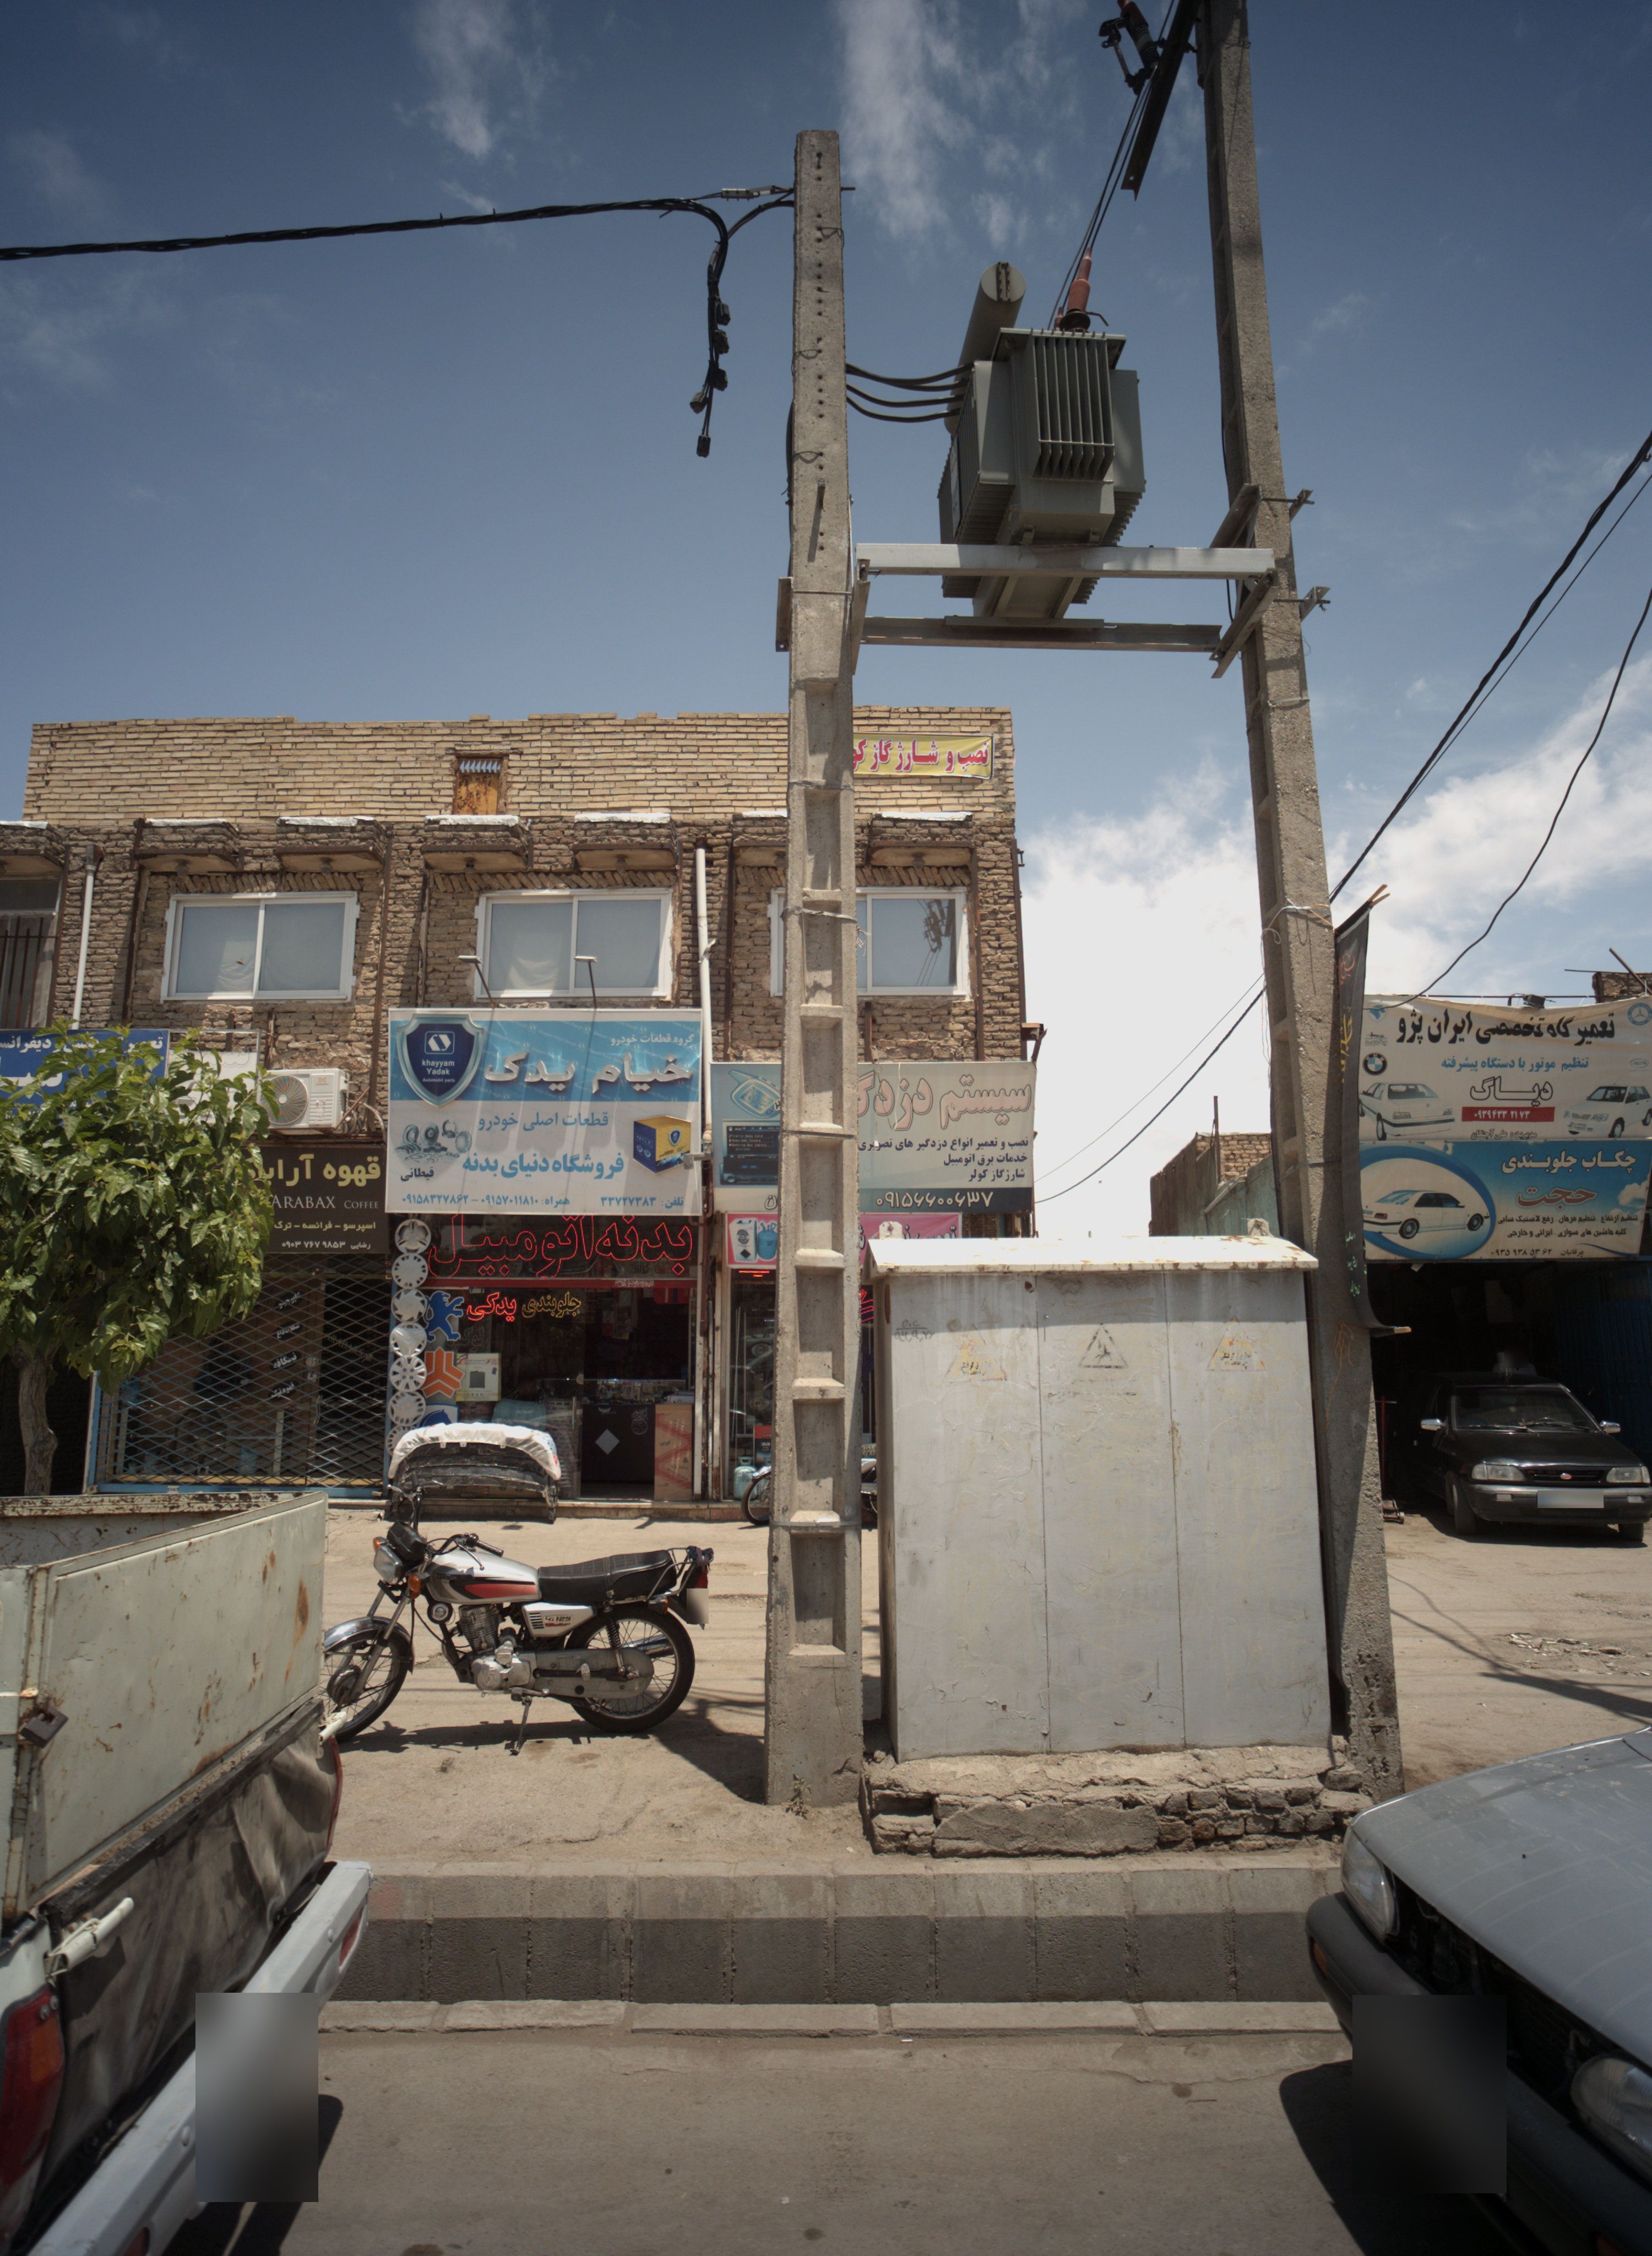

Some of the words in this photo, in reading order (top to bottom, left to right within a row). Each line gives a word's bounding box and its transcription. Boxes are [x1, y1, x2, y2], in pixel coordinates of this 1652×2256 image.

[870, 739, 892, 771] گاز
[895, 739, 938, 772] شارژ
[944, 750, 955, 772] و
[957, 742, 990, 770] نصب
[1396, 1008, 1423, 1045] پژو
[1427, 1008, 1473, 1044] ایران
[1476, 1016, 1544, 1045] تخصصی
[1574, 1013, 1615, 1046] تعمیر
[611, 1034, 637, 1046] خودرو
[640, 1033, 671, 1043] قطعات
[673, 1034, 694, 1045] گروه
[422, 1059, 455, 1067] khayyam
[1441, 1056, 1477, 1072] پیشرفته
[1481, 1057, 1515, 1069] دستگاه
[1518, 1057, 1525, 1071] با
[1528, 1058, 1556, 1072] موتور
[1561, 1056, 1589, 1072] تنظیم
[484, 1051, 577, 1092] یدک
[591, 1051, 694, 1094] خیام
[1470, 1076, 1553, 1107] دیاگ
[940, 1074, 1032, 1130] سیستم
[478, 1112, 518, 1131] خودرو
[523, 1112, 558, 1131] اصلی
[562, 1111, 609, 1127] قطعات
[895, 1138, 913, 1151] های
[916, 1138, 947, 1151] دزدگیر
[950, 1138, 972, 1151] انواع
[976, 1139, 998, 1151] تعمیر
[1001, 1141, 1006, 1150] و
[1008, 1138, 1029, 1149] نصب
[462, 1152, 499, 1178] بدنه
[943, 1153, 975, 1166] اتومبیل
[977, 1154, 994, 1166] برق
[996, 1153, 1028, 1163] خدمات
[1502, 1149, 1577, 1174] جلوبندی
[1582, 1149, 1637, 1174] چکاب
[323, 1156, 381, 1187] قهوه
[501, 1152, 550, 1179] دنیای
[552, 1152, 624, 1180] فروشگاه
[400, 1167, 434, 1181] قیطانی
[968, 1169, 988, 1182] کولر
[991, 1168, 1005, 1182] گاز
[1005, 1168, 1025, 1181] شارژ
[272, 1195, 336, 1209] ARABAX
[876, 1191, 994, 1208] ۰۹۱۵۶۶۰۰۶۳۷
[1517, 1186, 1597, 1211] حجت
[1578, 1215, 1596, 1223] تنظیم
[1620, 1214, 1638, 1223] تنظیم
[274, 1221, 292, 1231] ترک
[302, 1221, 333, 1231] فرانسه
[343, 1221, 376, 1233] اسپرسو
[1593, 1228, 1613, 1238] ماشین
[1507, 1229, 1528, 1238] خارجی
[1535, 1229, 1552, 1238] ایرانی
[1557, 1229, 1578, 1238] سواری
[1580, 1229, 1591, 1238] های
[350, 1241, 371, 1250] رضایی
[428, 1213, 594, 1278] اتومبیل
[595, 1215, 692, 1276] بدنه
[466, 1292, 518, 1322] یدکی
[522, 1292, 582, 1318] جلوبندی
